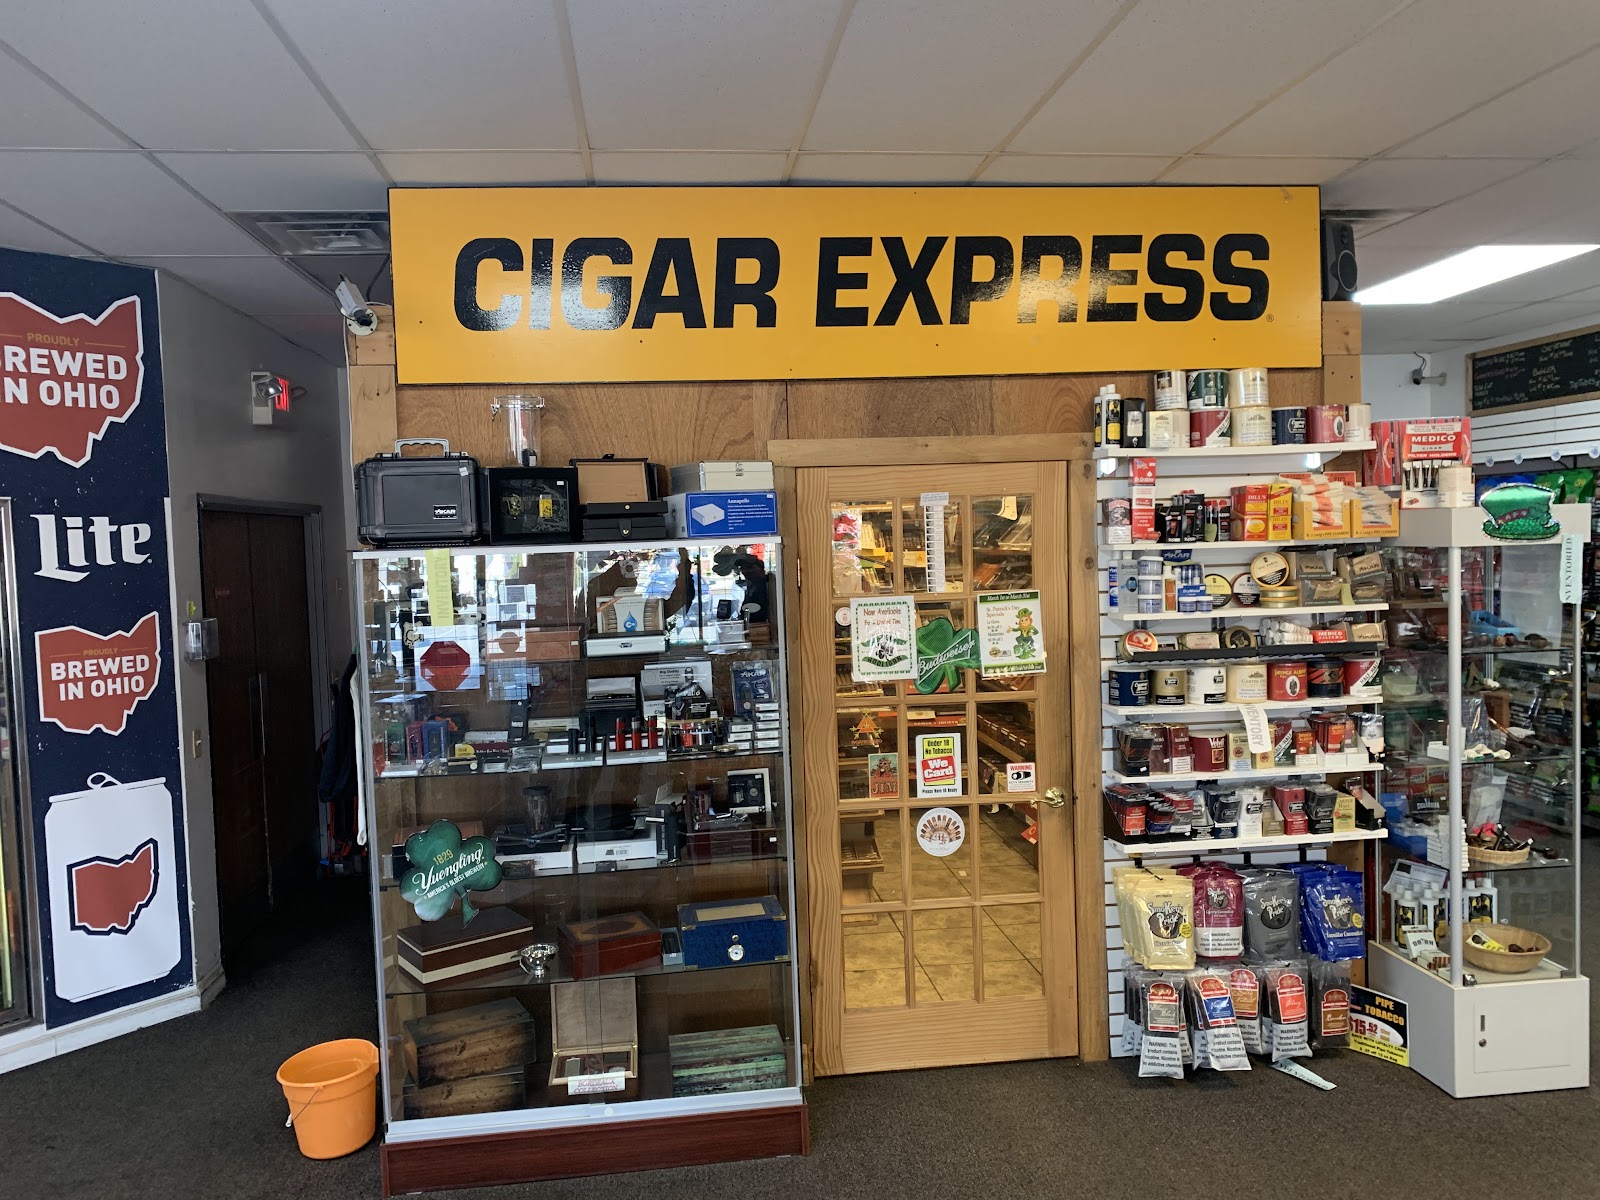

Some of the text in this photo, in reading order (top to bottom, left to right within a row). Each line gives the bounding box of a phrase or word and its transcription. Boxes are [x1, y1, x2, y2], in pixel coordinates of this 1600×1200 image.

[454, 233, 1270, 331] CIGAR EXPRESS
[27, 333, 80, 347] PROUDLY
[0, 345, 128, 380] REWED
[39, 380, 120, 410] OHIO
[1412, 434, 1456, 442] MEDICO
[30, 514, 151, 582] Lite
[434, 556, 450, 619] INVENTORY
[83, 647, 118, 656] PROUDLY
[919, 640, 976, 676] Budweiser
[50, 654, 150, 681] BREWED
[59, 676, 145, 701] IN OHIO
[1209, 738, 1224, 748] Velvet
[928, 759, 948, 768] We
[924, 766, 953, 778] Card
[872, 782, 896, 794] JIM
[433, 849, 454, 865] 1829
[412, 842, 484, 895] Yuengling
[427, 862, 485, 899] AMERICA'S OLDEST BREWERY
[1267, 906, 1284, 919] Pride
[1330, 904, 1350, 919] Pride
[1157, 913, 1179, 928] Pride
[1376, 996, 1394, 1010] PIPE
[1365, 1005, 1404, 1026] TOBACCO
[1375, 1039, 1393, 1048] LOYALTY
[574, 1085, 618, 1093] COLLECTION
[578, 1079, 615, 1087] BORDEAUX
